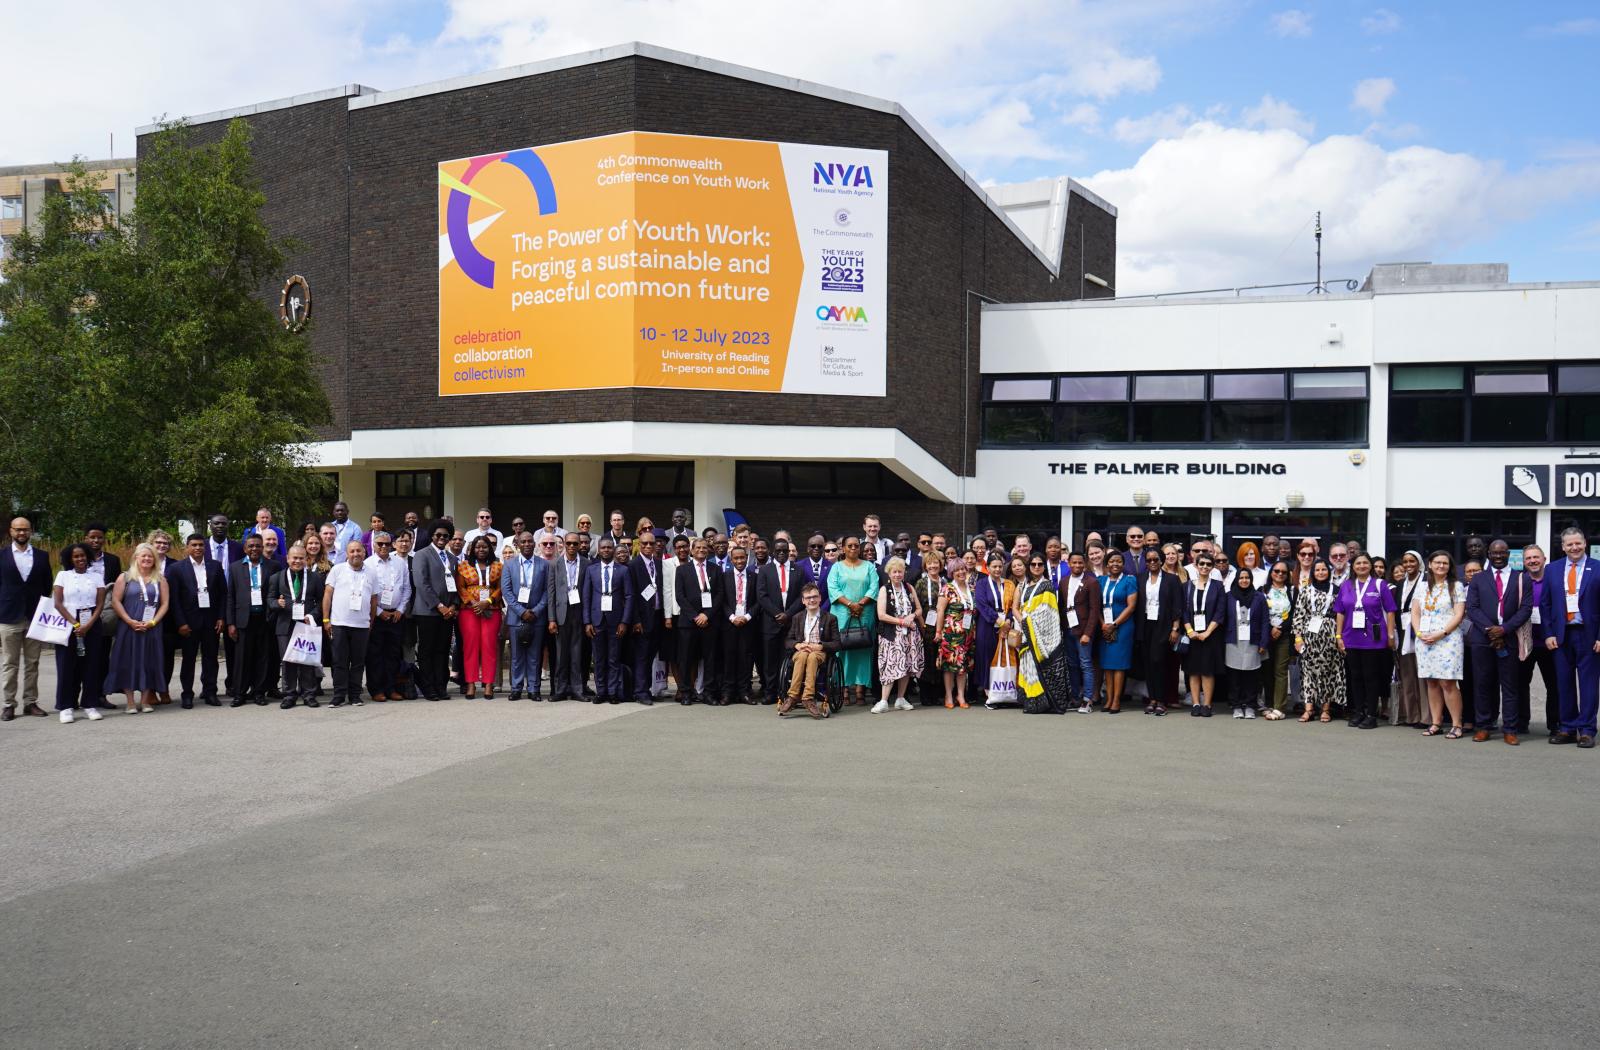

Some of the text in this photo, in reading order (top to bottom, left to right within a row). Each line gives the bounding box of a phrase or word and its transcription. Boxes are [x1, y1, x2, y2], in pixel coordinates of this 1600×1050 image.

[597, 154, 723, 171] 4th Commonwealth
[597, 171, 771, 191] Conference on Youth Work
[813, 162, 874, 188] NYA
[511, 219, 771, 253] The Power of Youth Work:
[813, 228, 874, 239] The Commonwealth
[511, 250, 771, 282] Forging a sustainable and
[821, 255, 864, 267] YOUTH
[821, 266, 864, 283] 2023
[511, 278, 771, 312] peaceful common future
[454, 328, 521, 345] celebration
[639, 327, 657, 341] 10
[671, 328, 689, 342] 12
[693, 328, 727, 347] July
[732, 330, 771, 345] 2023
[454, 346, 533, 364] collaboration
[661, 349, 770, 364] University of Reading
[454, 365, 526, 382] collectivism
[661, 362, 770, 376] In-person and Online
[1048, 463, 1287, 475] THE PALMER BUILDING
[39, 612, 68, 628] NYA
[655, 671, 667, 681] NY
[992, 680, 1016, 691] NYA
